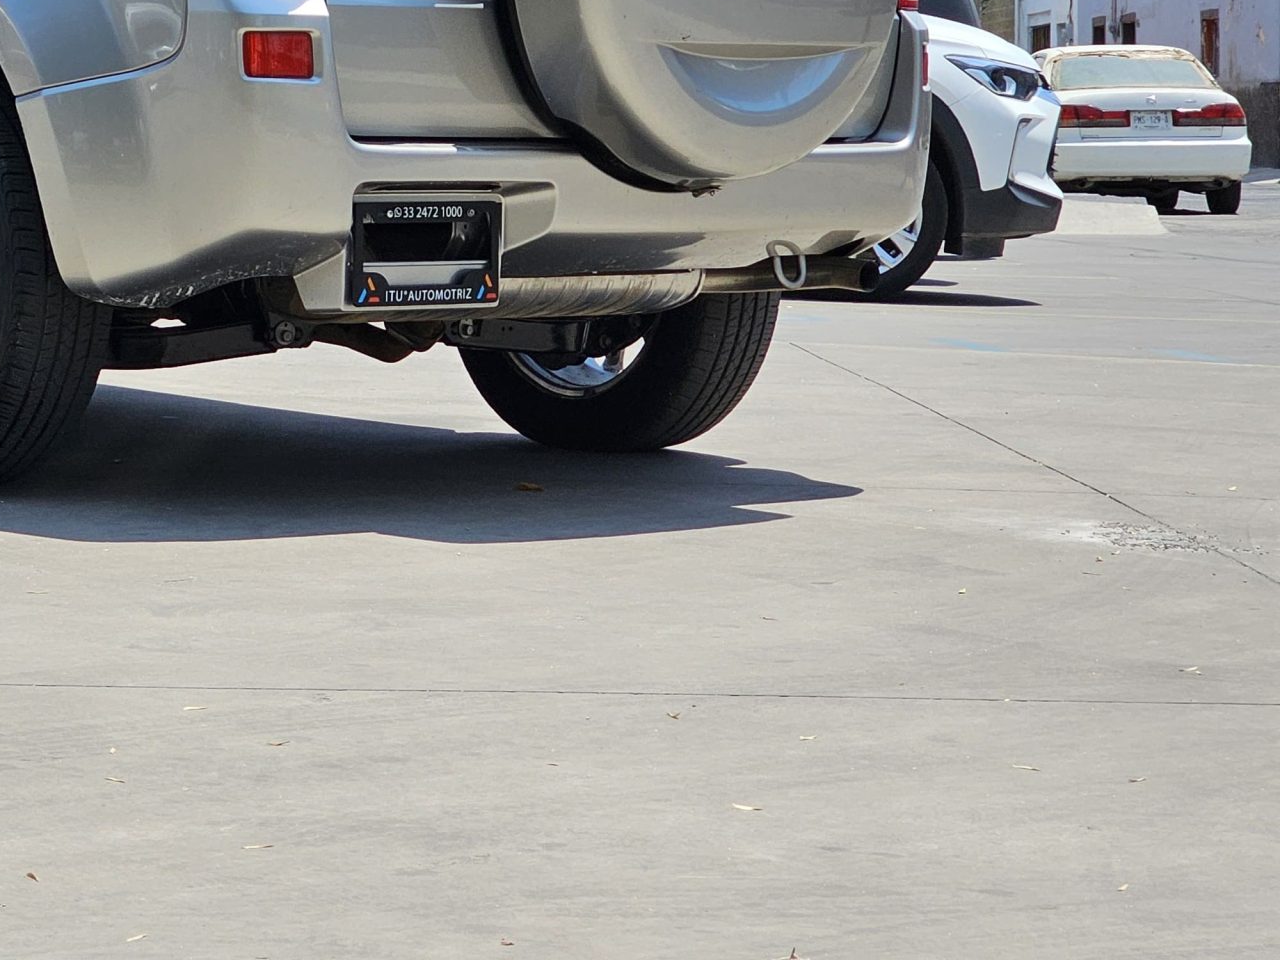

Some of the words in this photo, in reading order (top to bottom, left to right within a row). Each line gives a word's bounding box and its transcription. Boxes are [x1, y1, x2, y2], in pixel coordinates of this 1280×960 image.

[403, 206, 414, 218] 33
[416, 206, 439, 218] 2472
[441, 205, 463, 218] 1000
